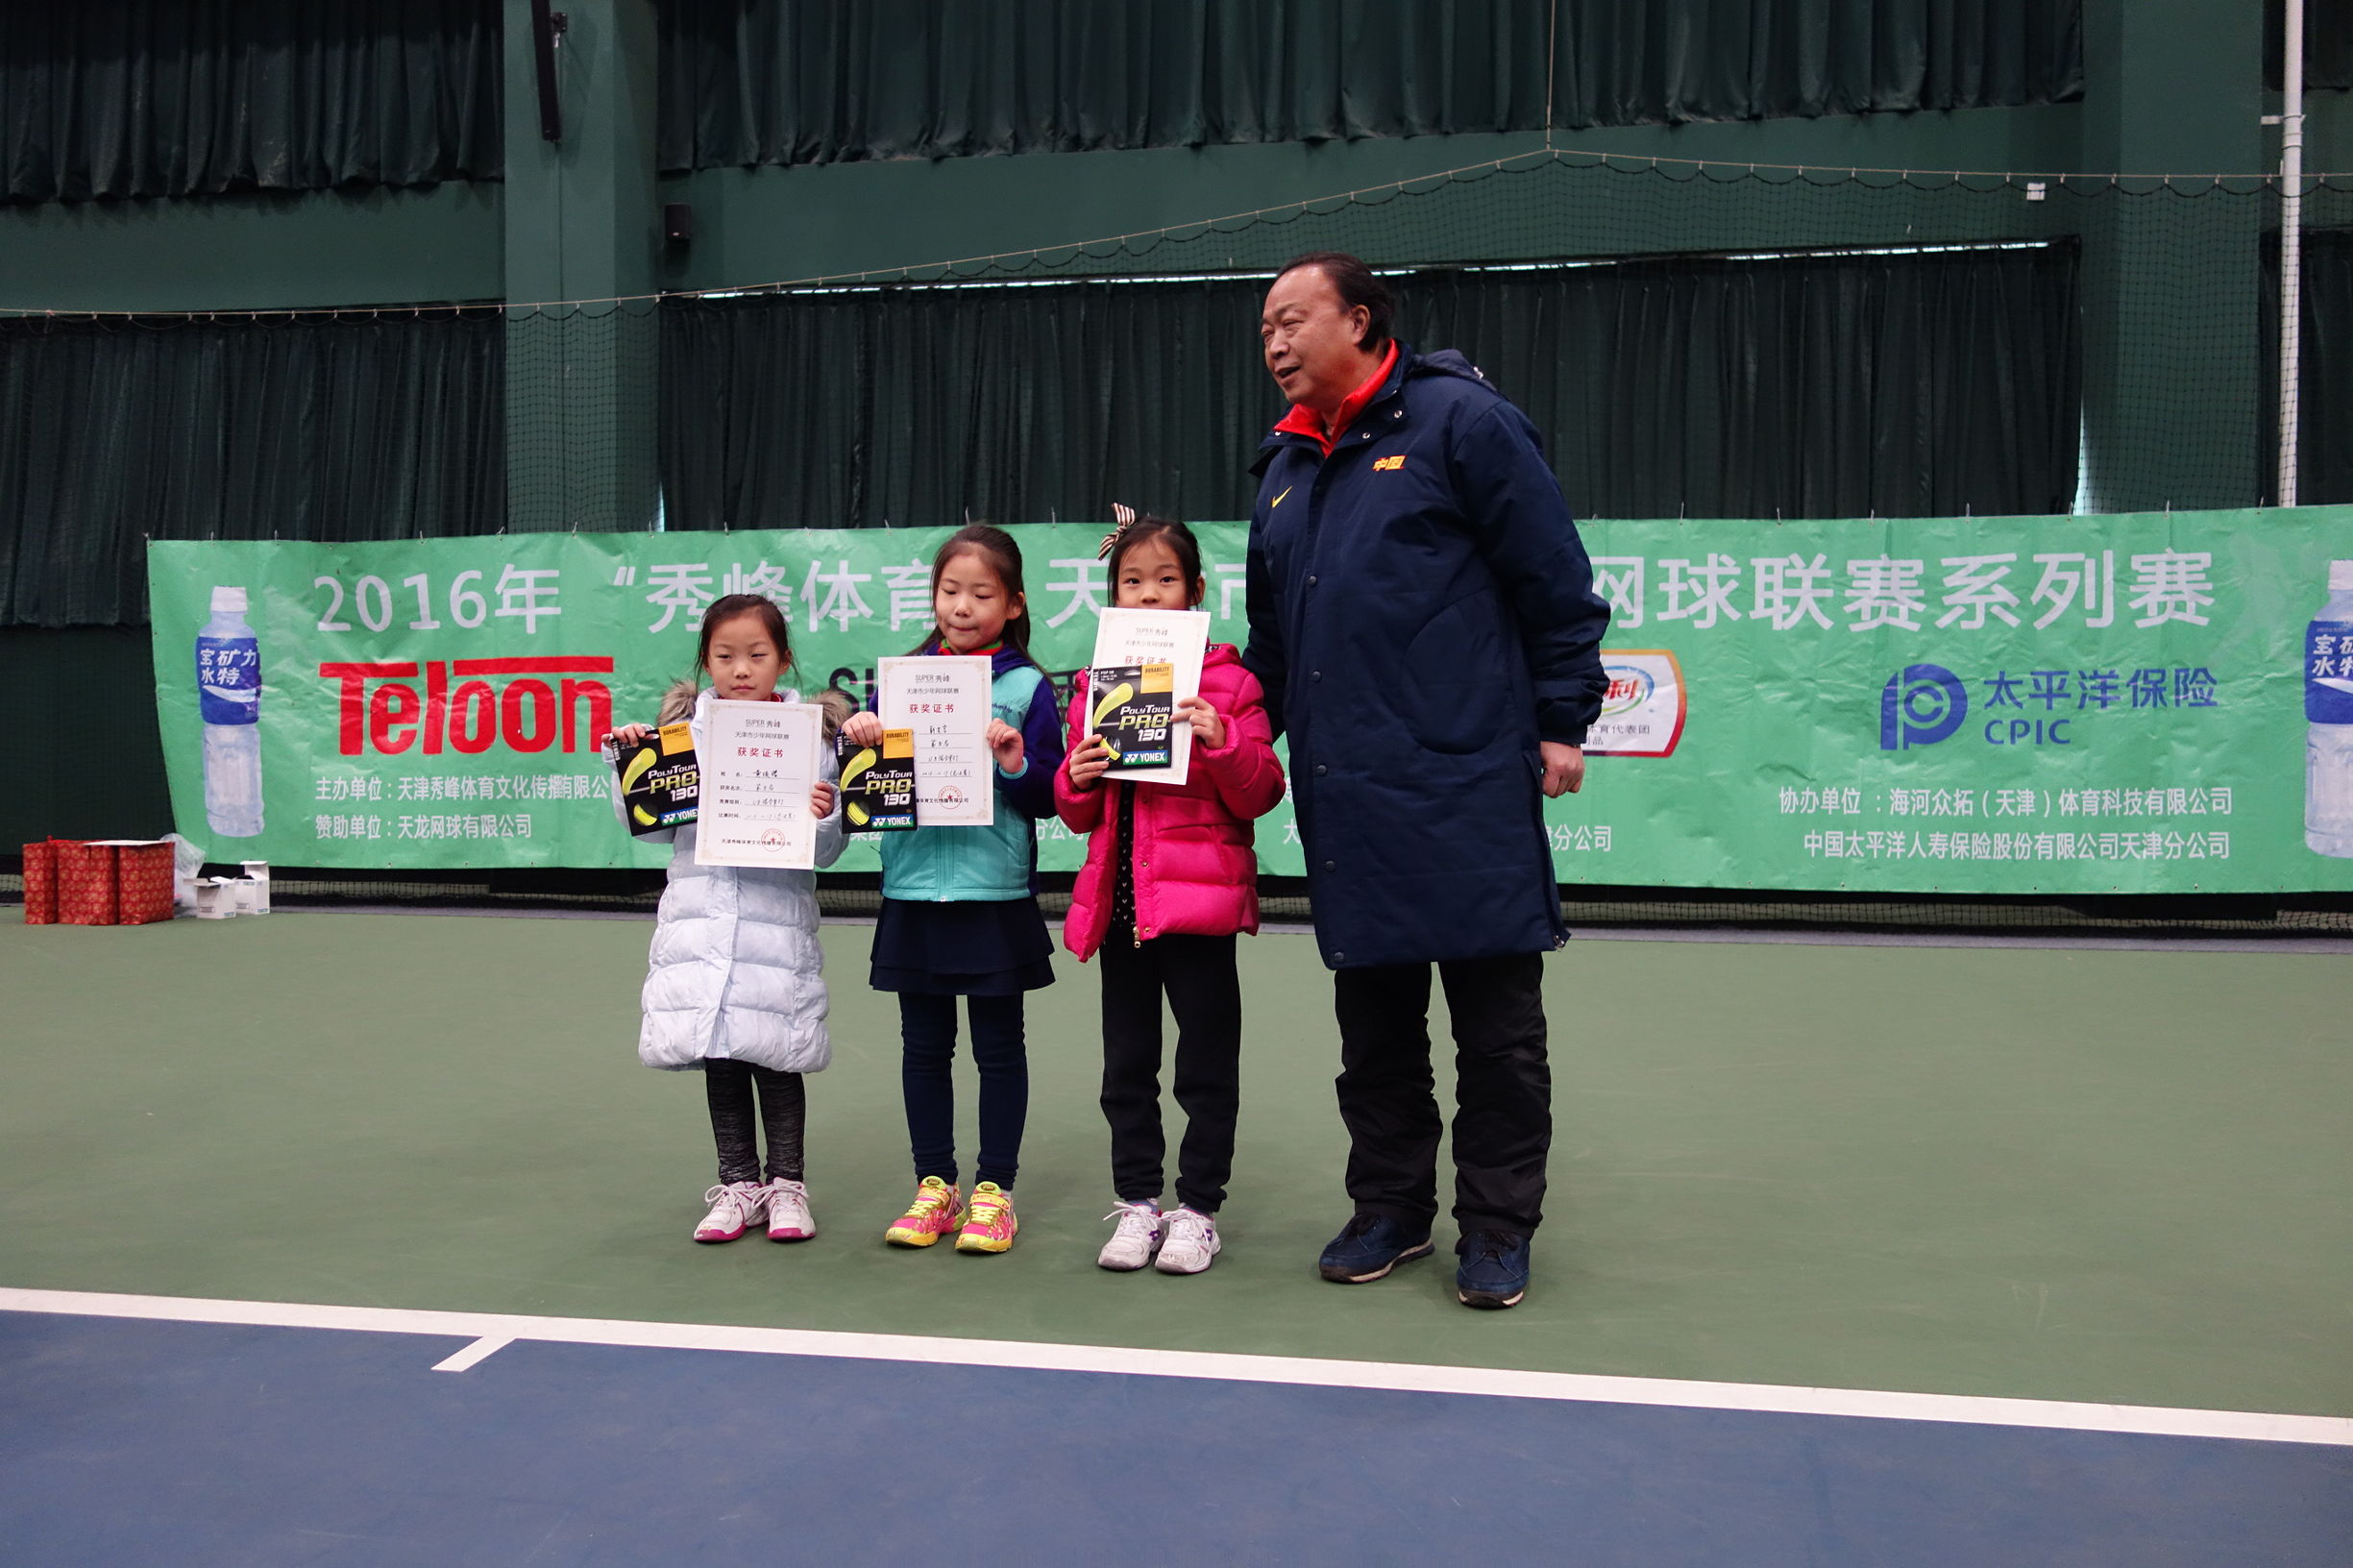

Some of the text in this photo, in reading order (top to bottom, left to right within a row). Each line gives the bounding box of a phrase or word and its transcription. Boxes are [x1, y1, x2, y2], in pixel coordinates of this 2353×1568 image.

[1372, 455, 1407, 471] 中国
[314, 564, 561, 634] 2016年
[1587, 548, 2215, 633] 网球联赛系列赛
[200, 648, 257, 667] 宝矿力
[201, 667, 240, 685] 水特
[1983, 667, 2218, 710] 太平洋保险
[318, 655, 615, 756] Teloon
[909, 703, 954, 713] 获奖证书
[1118, 713, 1169, 730] PRO
[1138, 728, 1167, 743] 130
[1984, 719, 2071, 745] CPIC
[737, 747, 784, 758] 获奖证书
[1140, 752, 1165, 763] YONEX
[650, 770, 699, 795] PRO
[865, 778, 912, 796] PRO
[670, 785, 699, 801] 130
[884, 793, 911, 806] 130
[887, 816, 911, 826] YONEX
[1803, 829, 2230, 861] 中国太平洋人寿保险股份有限公司天津分公司
